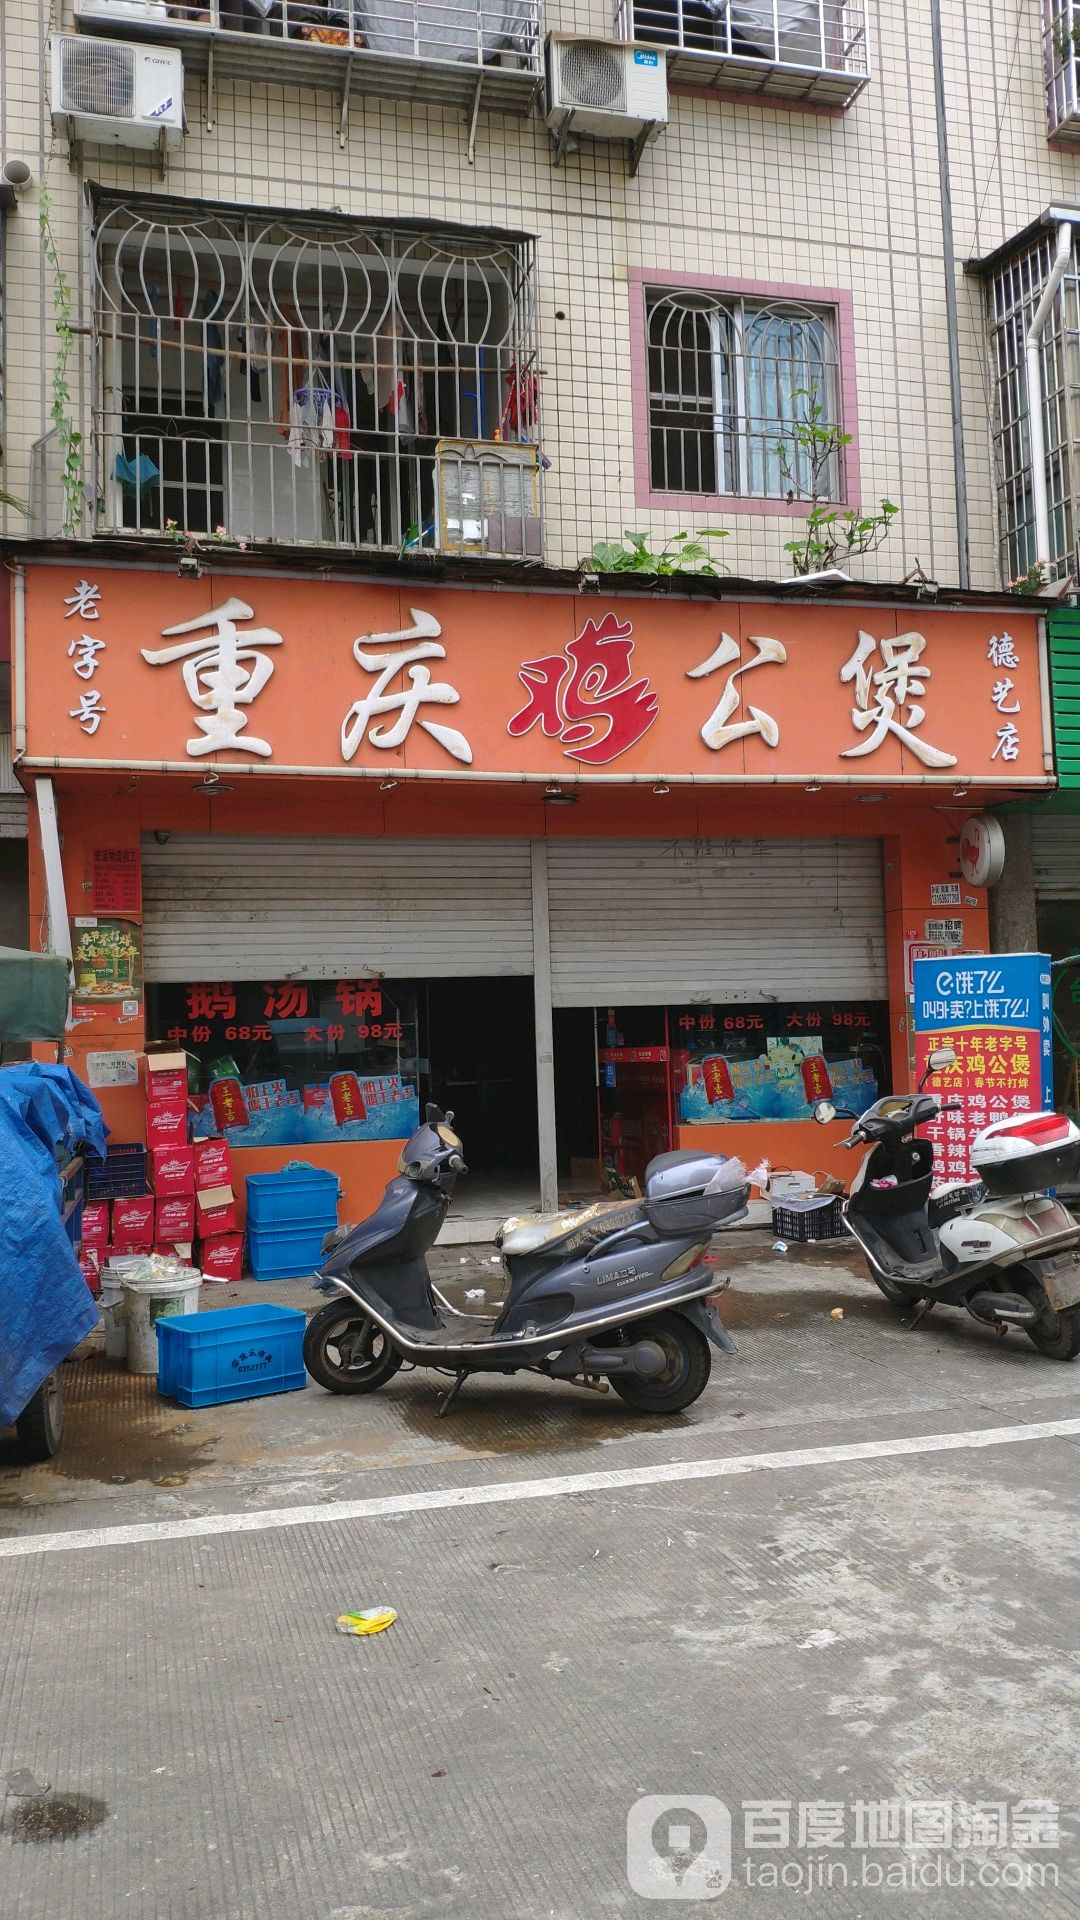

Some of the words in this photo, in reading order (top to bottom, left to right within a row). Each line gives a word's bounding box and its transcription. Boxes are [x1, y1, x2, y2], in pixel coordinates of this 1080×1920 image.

[63, 578, 107, 736] 老字号
[140, 597, 958, 768] 重庆鸡公煲
[987, 631, 1020, 763] 德艺店
[186, 978, 383, 1020] 鹅汤锅
[167, 1025, 212, 1043] 中份
[225, 1024, 273, 1041] 68元
[303, 1024, 345, 1042] 大份
[357, 1022, 403, 1040] 98元
[679, 1014, 716, 1030] 中份
[724, 1014, 764, 1030] 68元
[786, 1012, 822, 1028] 大份
[832, 1011, 871, 1027] 98元
[927, 1035, 1028, 1053] 正宗十年老字号
[710, 1062, 723, 1095] 王老吉
[810, 1062, 822, 1095] 王老吉
[221, 1085, 236, 1122] 王老吉
[340, 1080, 354, 1116] 王老吉
